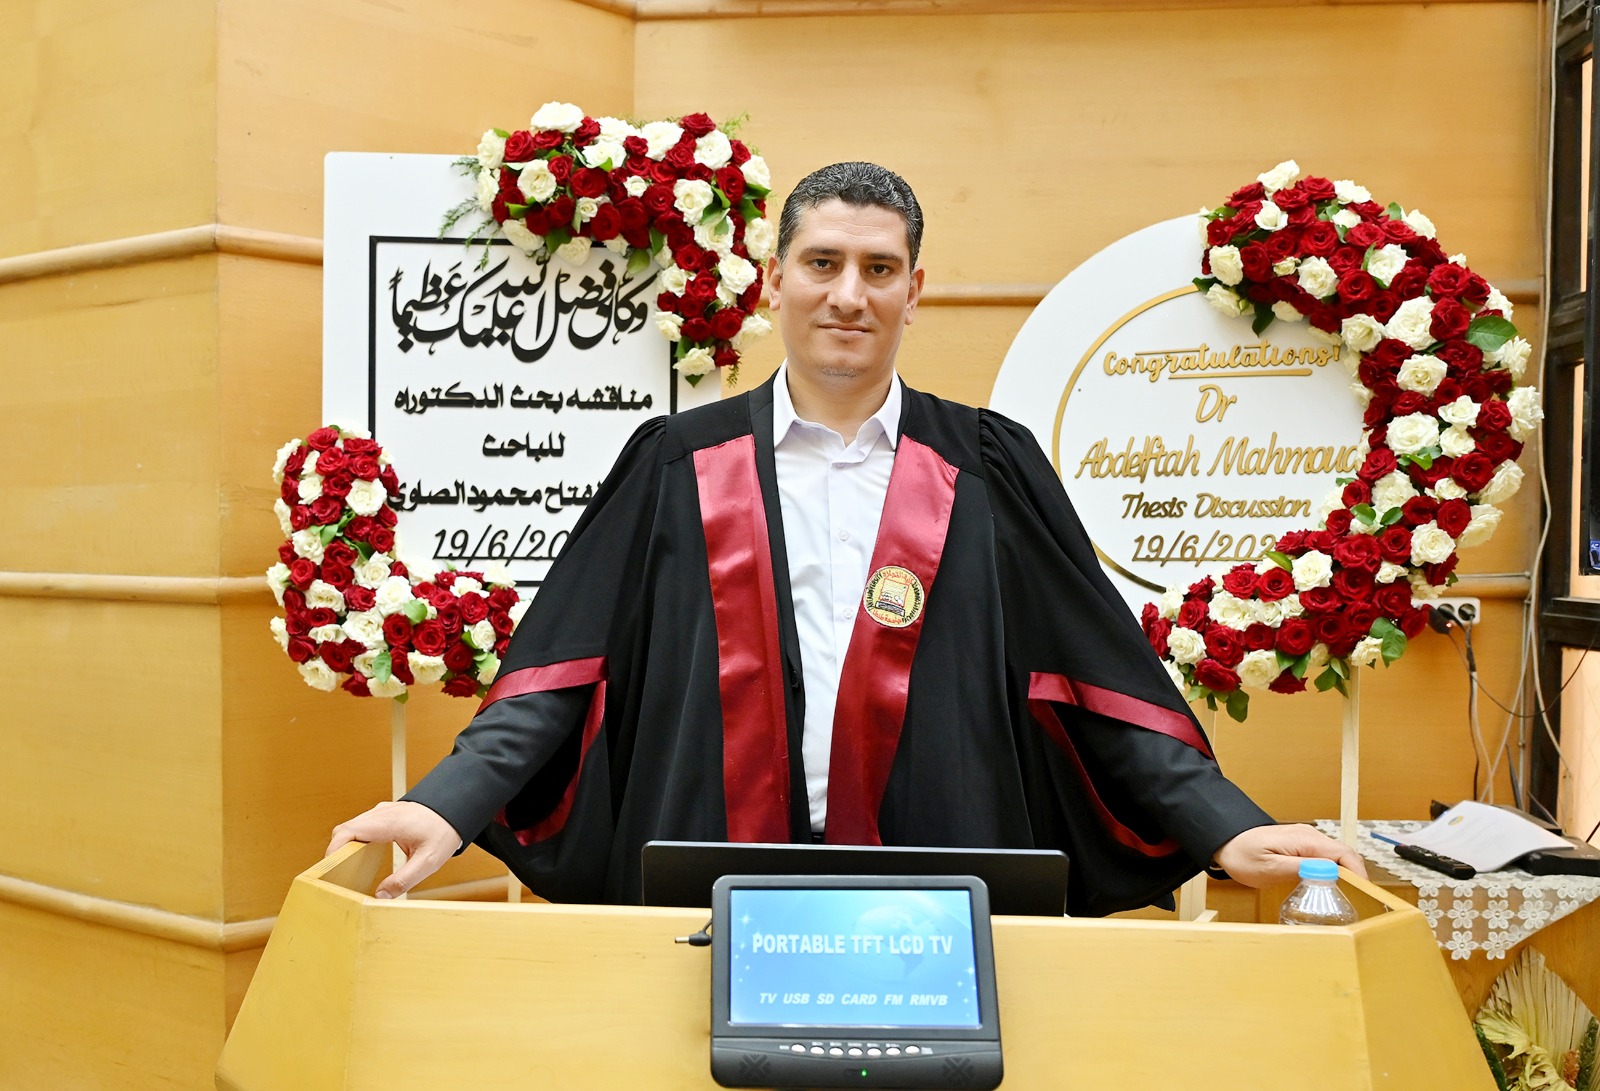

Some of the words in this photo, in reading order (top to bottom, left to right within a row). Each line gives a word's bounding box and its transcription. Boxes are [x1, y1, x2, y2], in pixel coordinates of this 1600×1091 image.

[394, 380, 504, 415] الدكتوراه
[510, 384, 563, 414] بحث
[566, 384, 653, 411] مناقشه
[1196, 384, 1237, 423] Dr
[482, 432, 566, 463] للباحث
[1075, 434, 1200, 484] Abdelftah
[467, 484, 543, 513] محمود
[1121, 492, 1187, 519] Thesis
[1193, 492, 1311, 519] Discussion
[433, 524, 571, 568] 19/6/20
[1132, 529, 1277, 568] 19/6/202
[752, 934, 846, 954] PORTABLE
[851, 935, 884, 954] TFT
[889, 935, 924, 955] LCD
[929, 936, 953, 955] TV
[759, 992, 777, 1005] TV
[783, 993, 810, 1005] USB
[816, 993, 835, 1005] SD
[841, 993, 878, 1006] CARD
[884, 994, 903, 1006] FM
[909, 994, 948, 1006] RMVB
